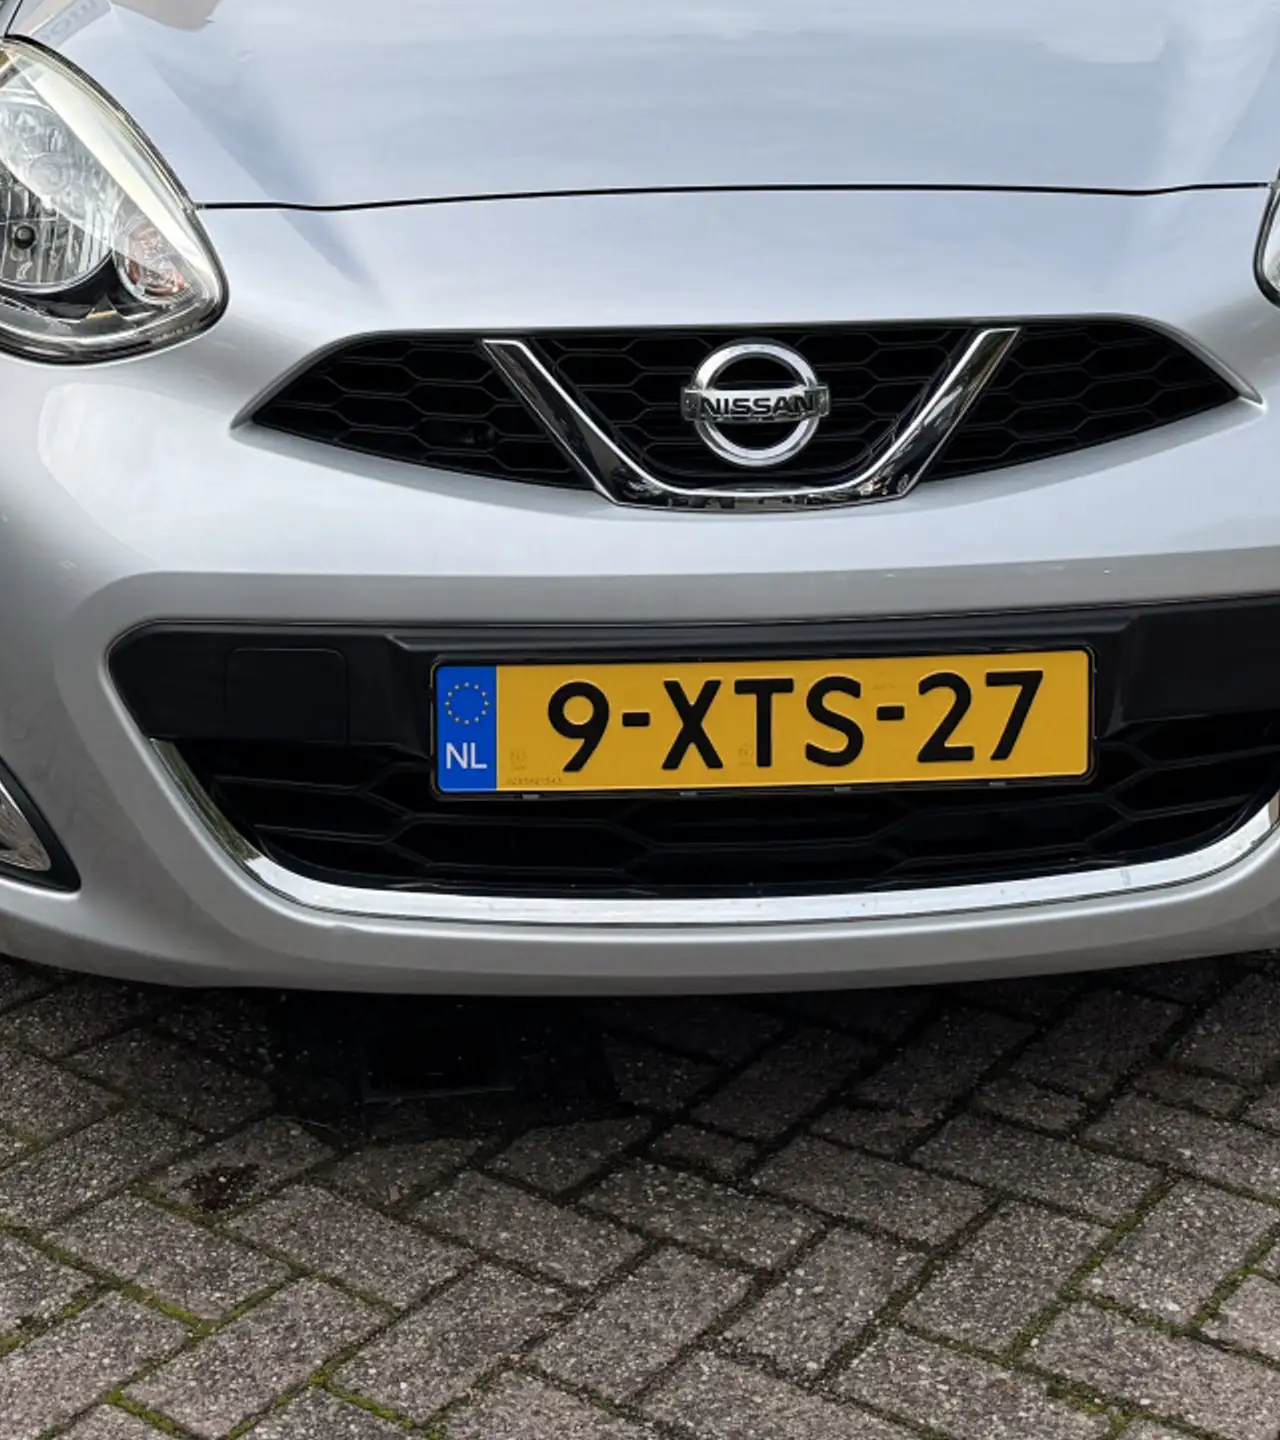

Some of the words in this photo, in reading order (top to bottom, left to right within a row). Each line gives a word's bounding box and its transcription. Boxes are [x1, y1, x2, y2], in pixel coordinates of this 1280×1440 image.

[699, 394, 814, 417] NISSAN
[445, 741, 488, 770] NL
[547, 670, 1044, 773] 9-XTS-27
